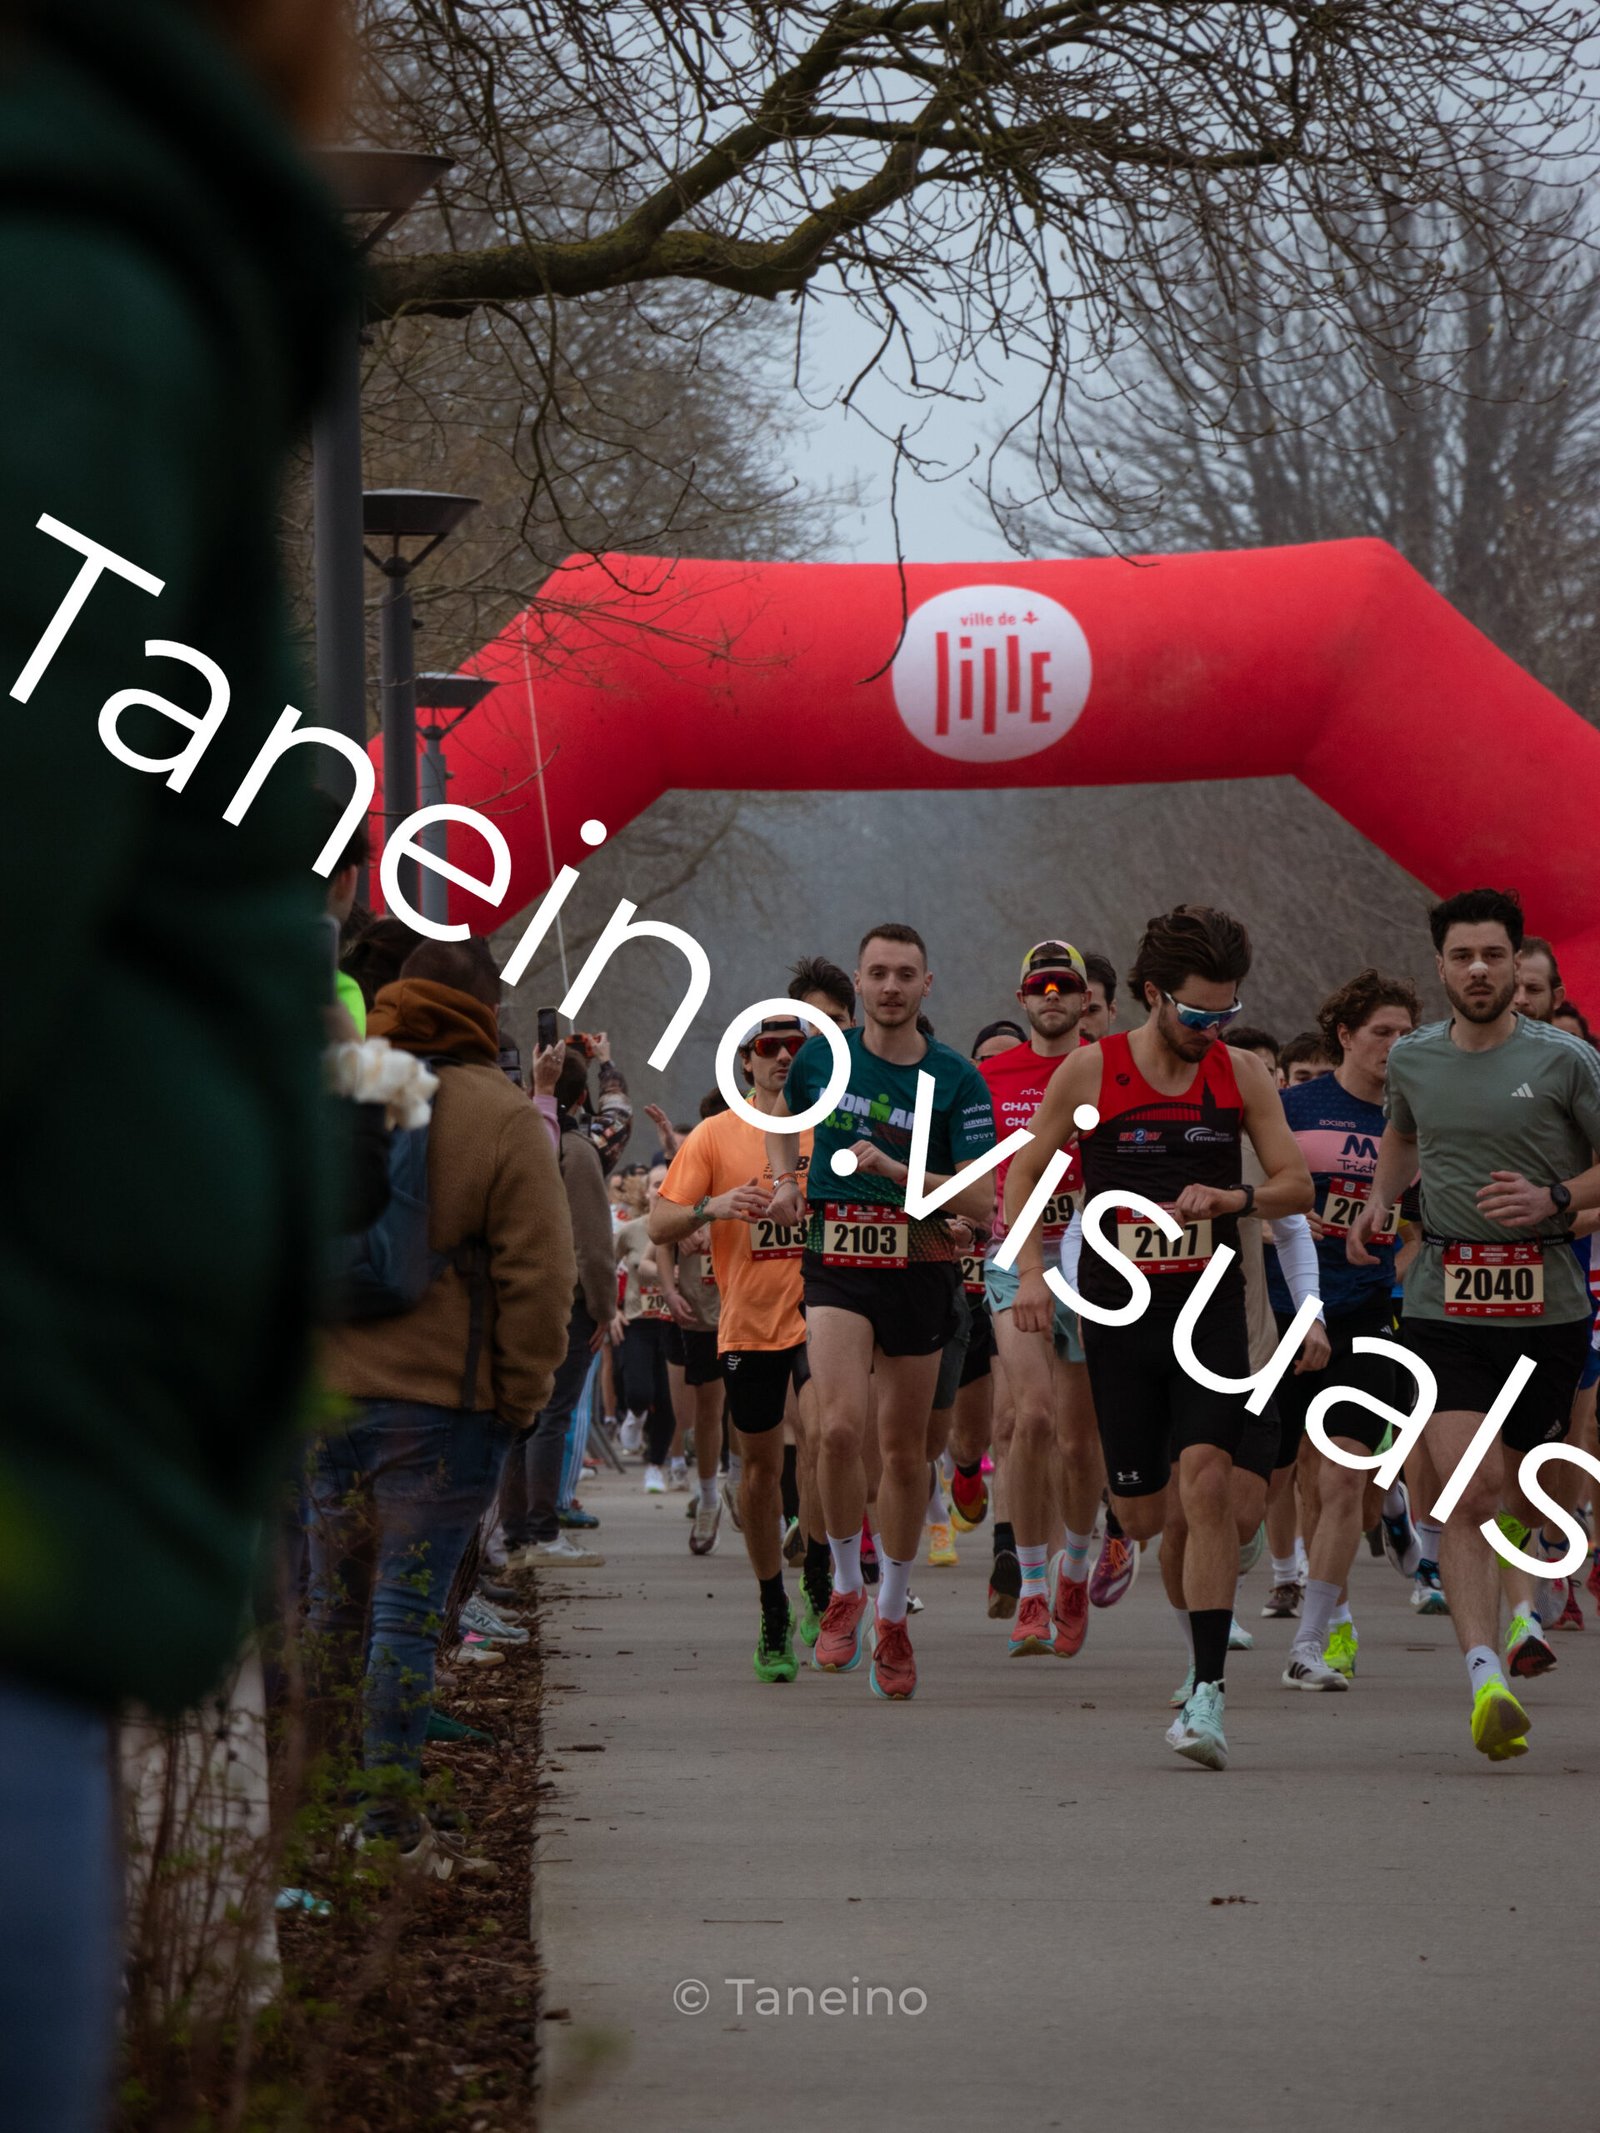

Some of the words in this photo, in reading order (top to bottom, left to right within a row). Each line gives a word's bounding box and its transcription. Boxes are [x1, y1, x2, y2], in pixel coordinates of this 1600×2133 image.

[960, 613, 993, 626] ville
[998, 611, 1016, 625] de
[962, 1103, 991, 1115] wahoo
[833, 1223, 897, 1255] 2103
[1455, 1267, 1534, 1301] 2040
